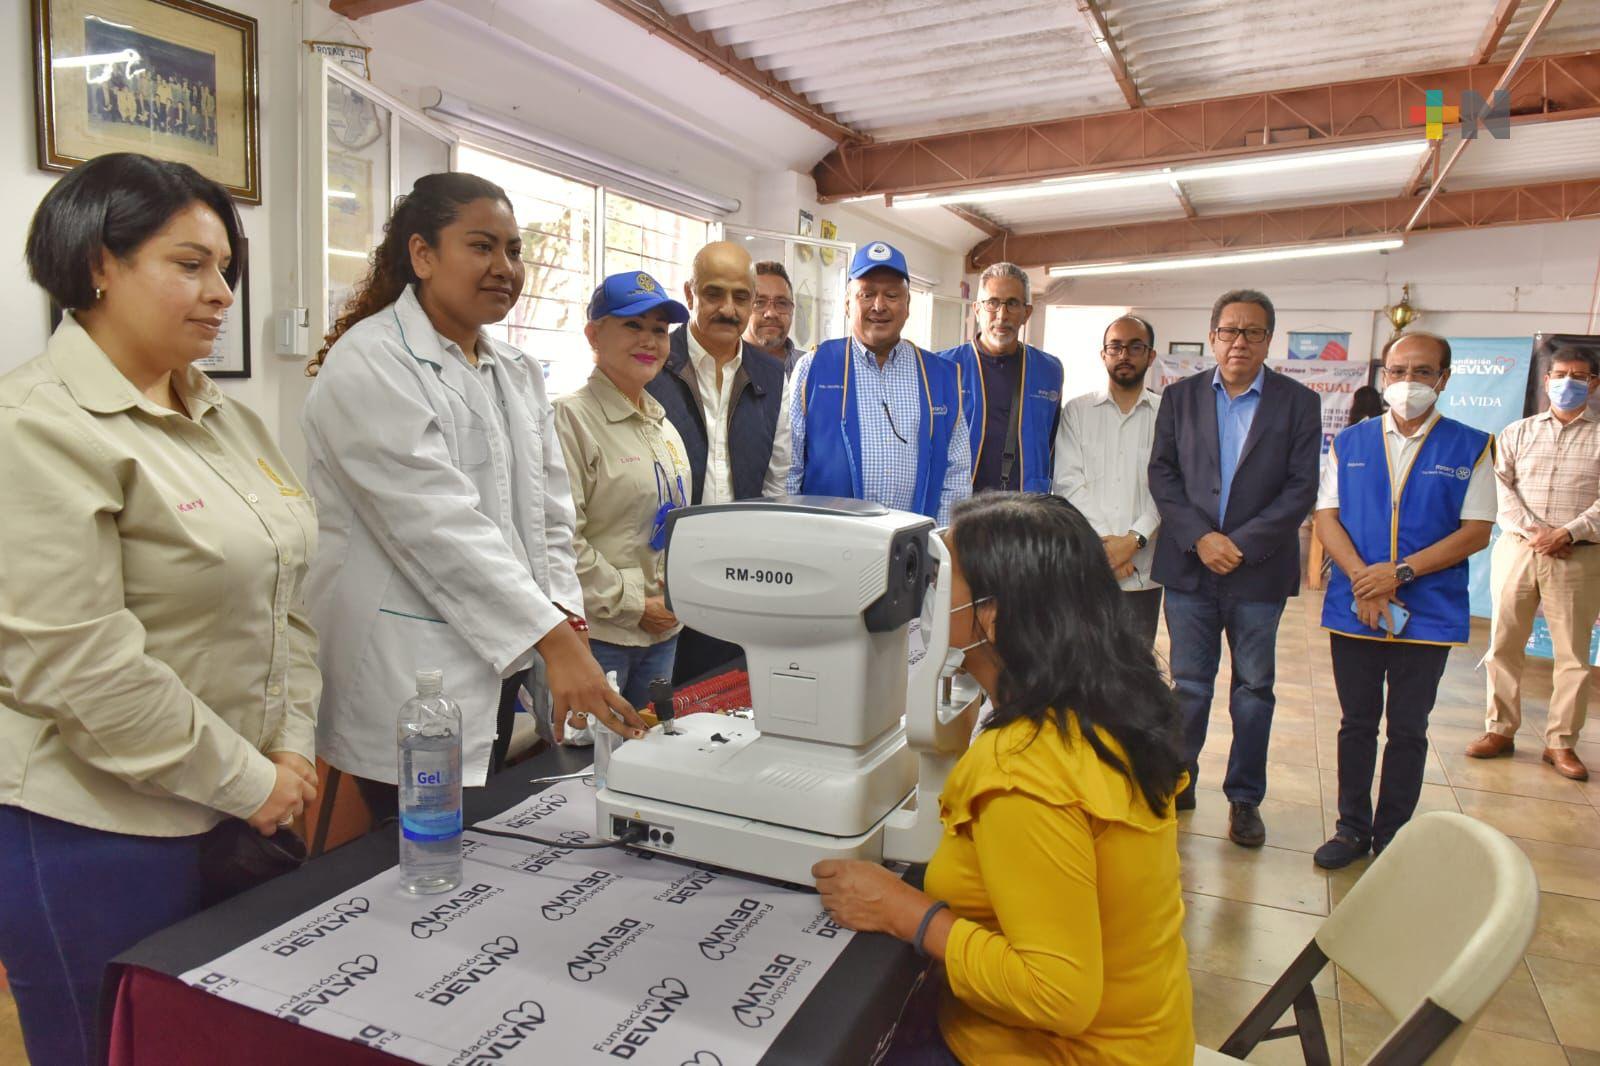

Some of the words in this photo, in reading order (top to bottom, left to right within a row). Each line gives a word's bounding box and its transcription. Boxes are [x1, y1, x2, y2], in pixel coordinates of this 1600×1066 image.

[317, 45, 345, 57] ROTARY
[1452, 357, 1491, 366] undación
[1450, 394, 1467, 407] LA
[1469, 396, 1503, 408] VIDA
[177, 498, 204, 512] Kary
[725, 567, 793, 585] RM-9000
[417, 771, 441, 784] Gel
[506, 799, 567, 829] DEVLYN
[412, 883, 493, 928] DEVLYN
[443, 887, 505, 922] Fundación
[541, 870, 611, 911] DEVLYN
[667, 871, 718, 904] DEVLY
[261, 911, 336, 951] Fundación
[273, 906, 370, 957] DEVLYN
[567, 918, 642, 969] DEVLYN
[601, 923, 655, 962] Fundación
[698, 898, 761, 949] DEVLYN
[730, 903, 774, 943] Fundación
[274, 973, 341, 1017] undación
[414, 953, 485, 1000] Fundación
[428, 947, 519, 1006] DEVLYN
[732, 953, 796, 1014] DEVLYN
[766, 959, 812, 1006] Fundación
[447, 1023, 508, 1066] ndación
[464, 1015, 546, 1066] EVLYN
[592, 998, 655, 1053] Fundación
[610, 990, 690, 1060] DEVLYN
